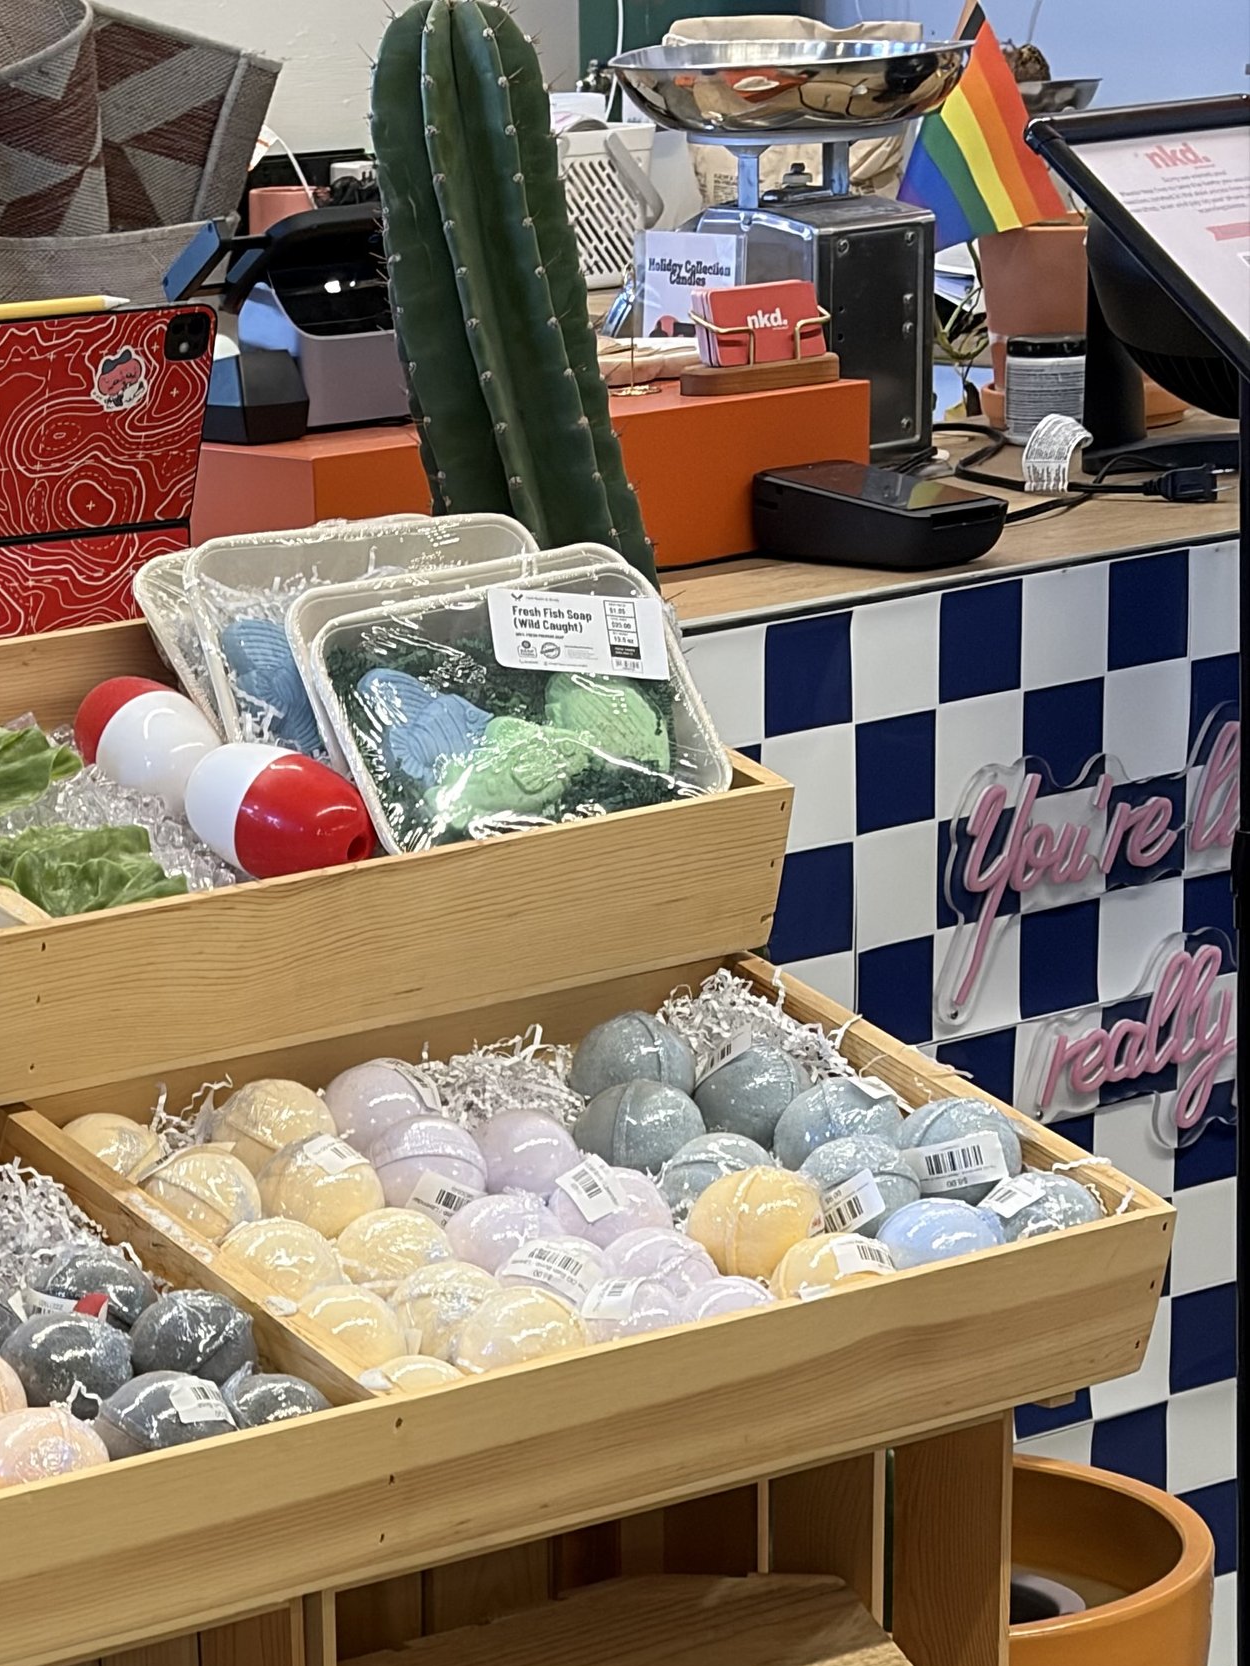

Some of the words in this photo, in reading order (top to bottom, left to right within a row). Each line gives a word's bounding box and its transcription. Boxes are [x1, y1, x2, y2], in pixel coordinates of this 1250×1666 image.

[1145, 142, 1212, 169] nkd.
[648, 258, 683, 274] Holiday
[684, 260, 731, 277] Collection
[669, 271, 707, 287] Candles
[747, 307, 788, 329] nkd.
[512, 605, 541, 618] Fresh
[543, 608, 565, 619] Fish
[566, 610, 593, 623] Soap
[513, 617, 541, 630] (Wild
[543, 621, 583, 634] Caught)
[955, 773, 1178, 1006] You're
[1040, 944, 1236, 1129] really
